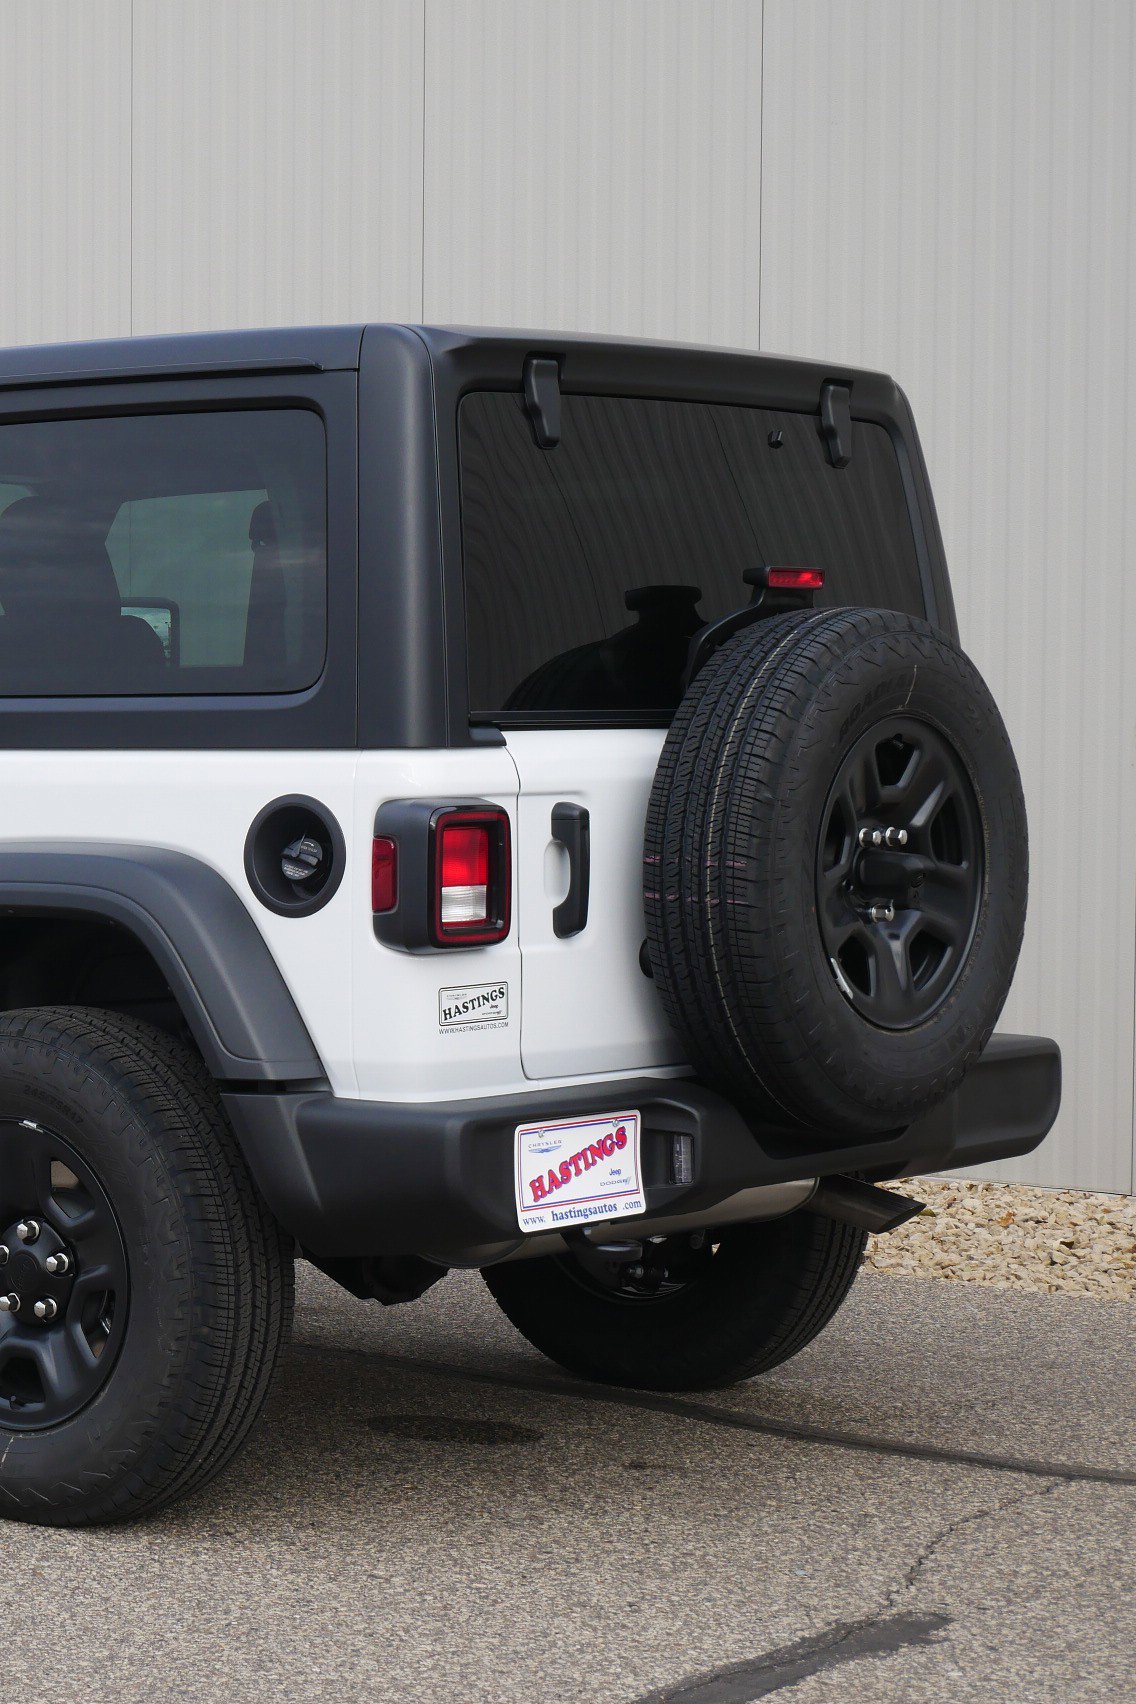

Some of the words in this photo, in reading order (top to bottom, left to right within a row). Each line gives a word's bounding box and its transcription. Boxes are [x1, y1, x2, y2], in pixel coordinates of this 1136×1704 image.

[442, 986, 505, 1021] HASTINGS
[528, 1139, 562, 1149] CHRYSLER
[529, 1126, 627, 1202] HASTINGS
[609, 1168, 622, 1177] Jeep
[523, 1216, 546, 1226] www.
[551, 1202, 618, 1222] hastingsautos
[622, 1200, 642, 1211] .com
